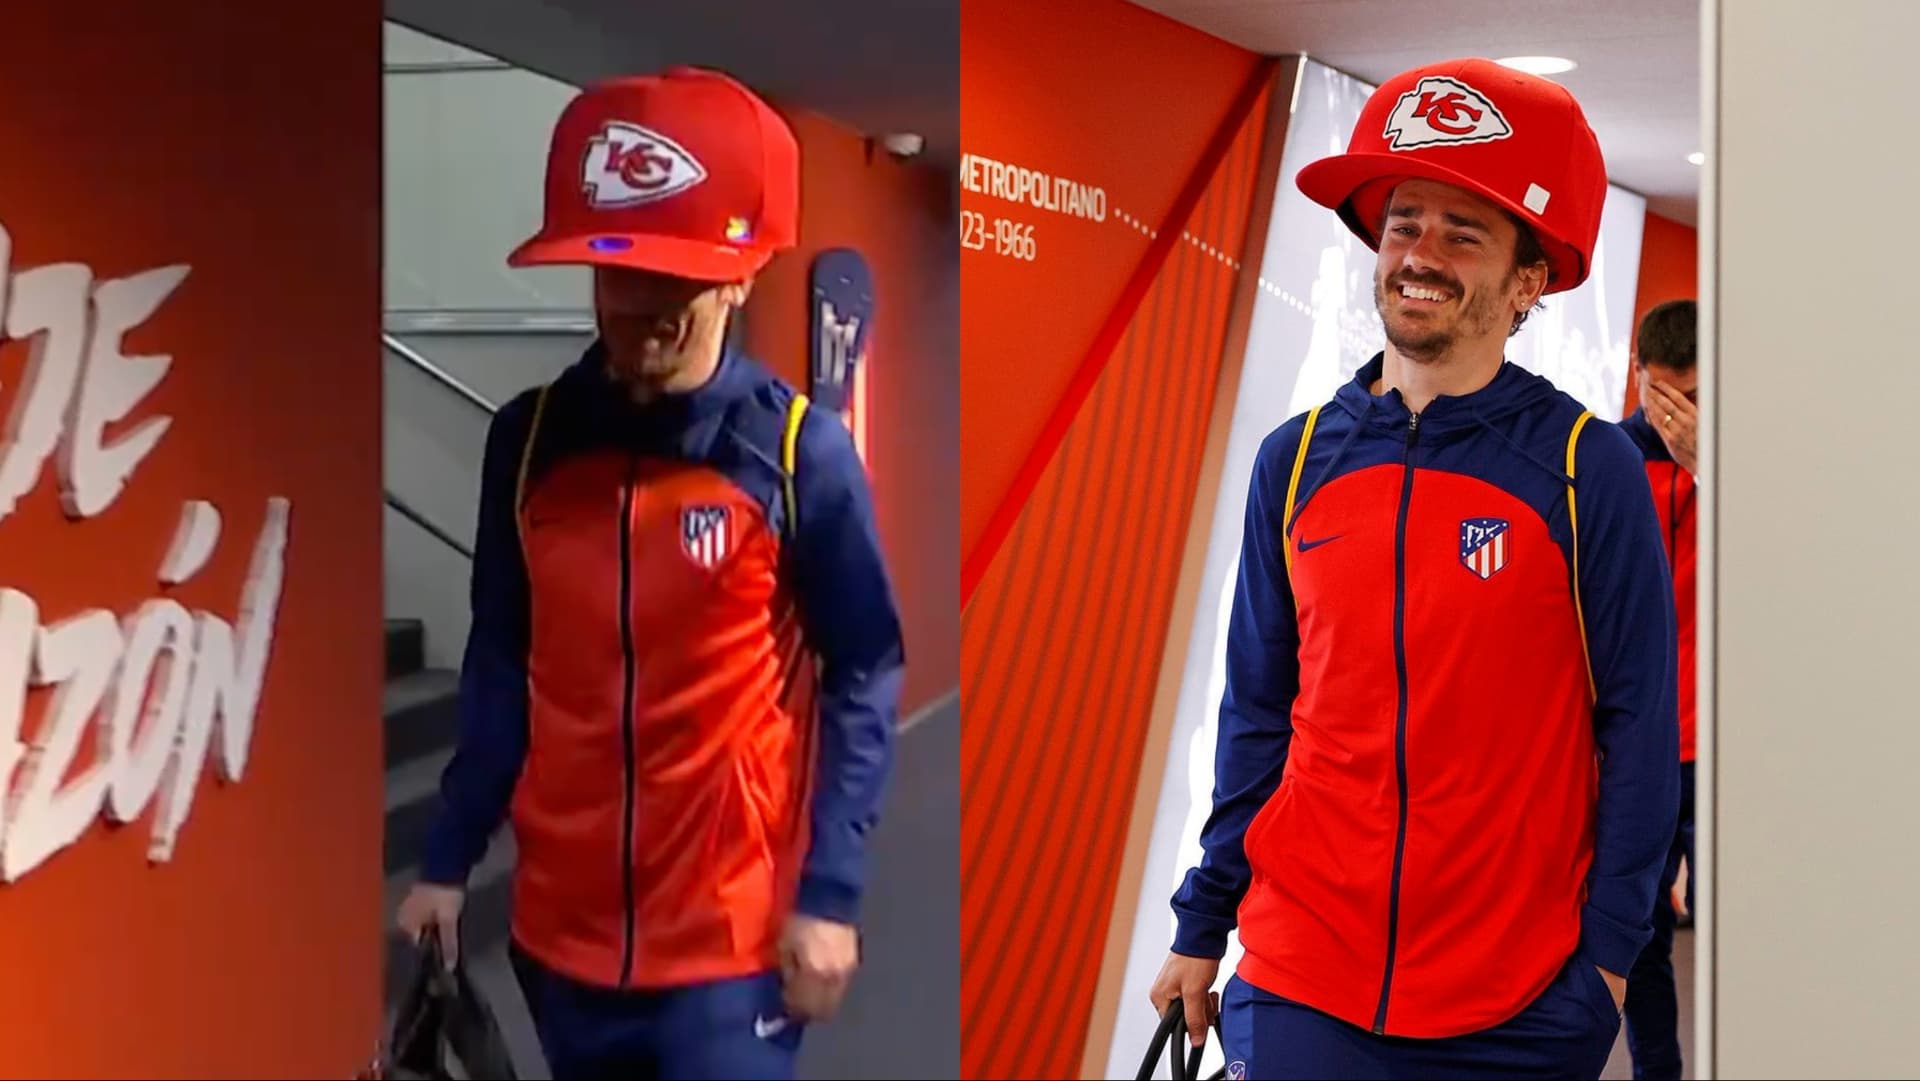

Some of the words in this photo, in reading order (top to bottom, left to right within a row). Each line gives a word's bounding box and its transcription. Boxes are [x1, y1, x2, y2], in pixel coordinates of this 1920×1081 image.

[1411, 91, 1483, 135] KC
[604, 141, 673, 189] KC
[960, 209, 1036, 261] 23-1966
